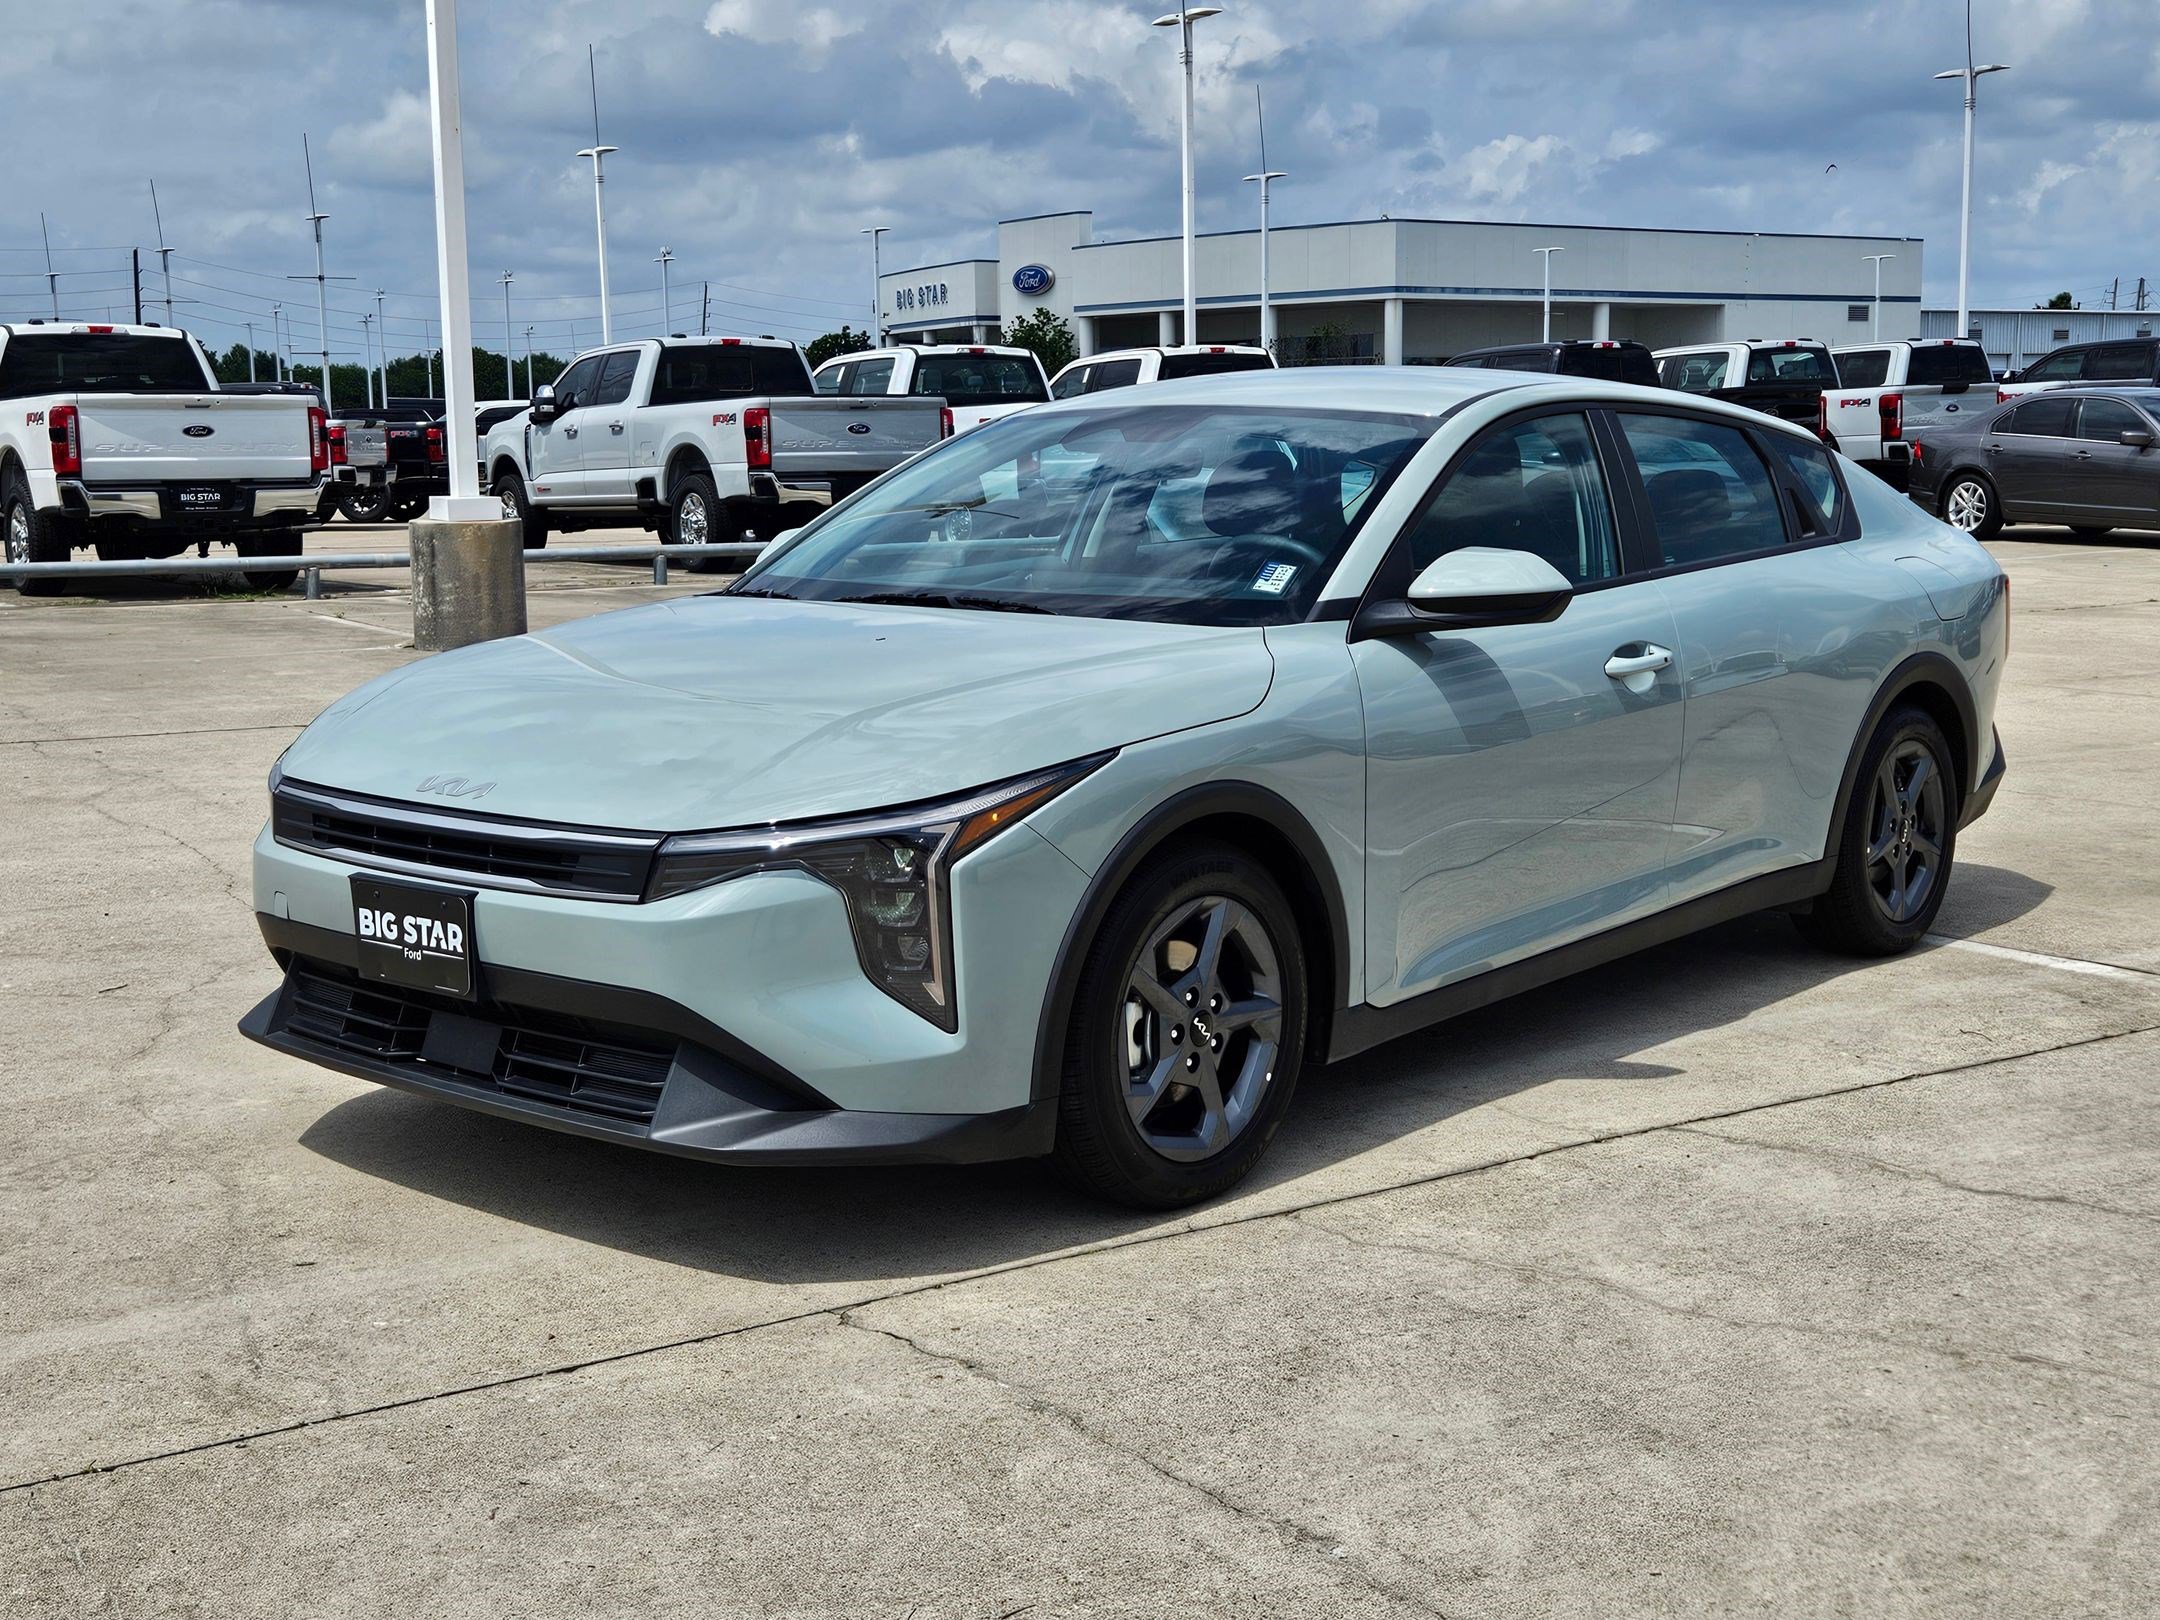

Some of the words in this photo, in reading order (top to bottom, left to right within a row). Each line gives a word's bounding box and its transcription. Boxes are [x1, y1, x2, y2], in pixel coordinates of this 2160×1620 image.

[1018, 271, 1041, 289] Ford
[896, 290, 915, 310] BIG
[918, 283, 949, 308] STAR
[1840, 398, 1871, 408] FX4
[712, 412, 737, 426] FX4
[181, 493, 196, 501] BIG
[197, 493, 221, 501] STAR
[359, 907, 398, 940] BIG
[402, 915, 464, 954] STAR
[404, 947, 422, 961] Ford
